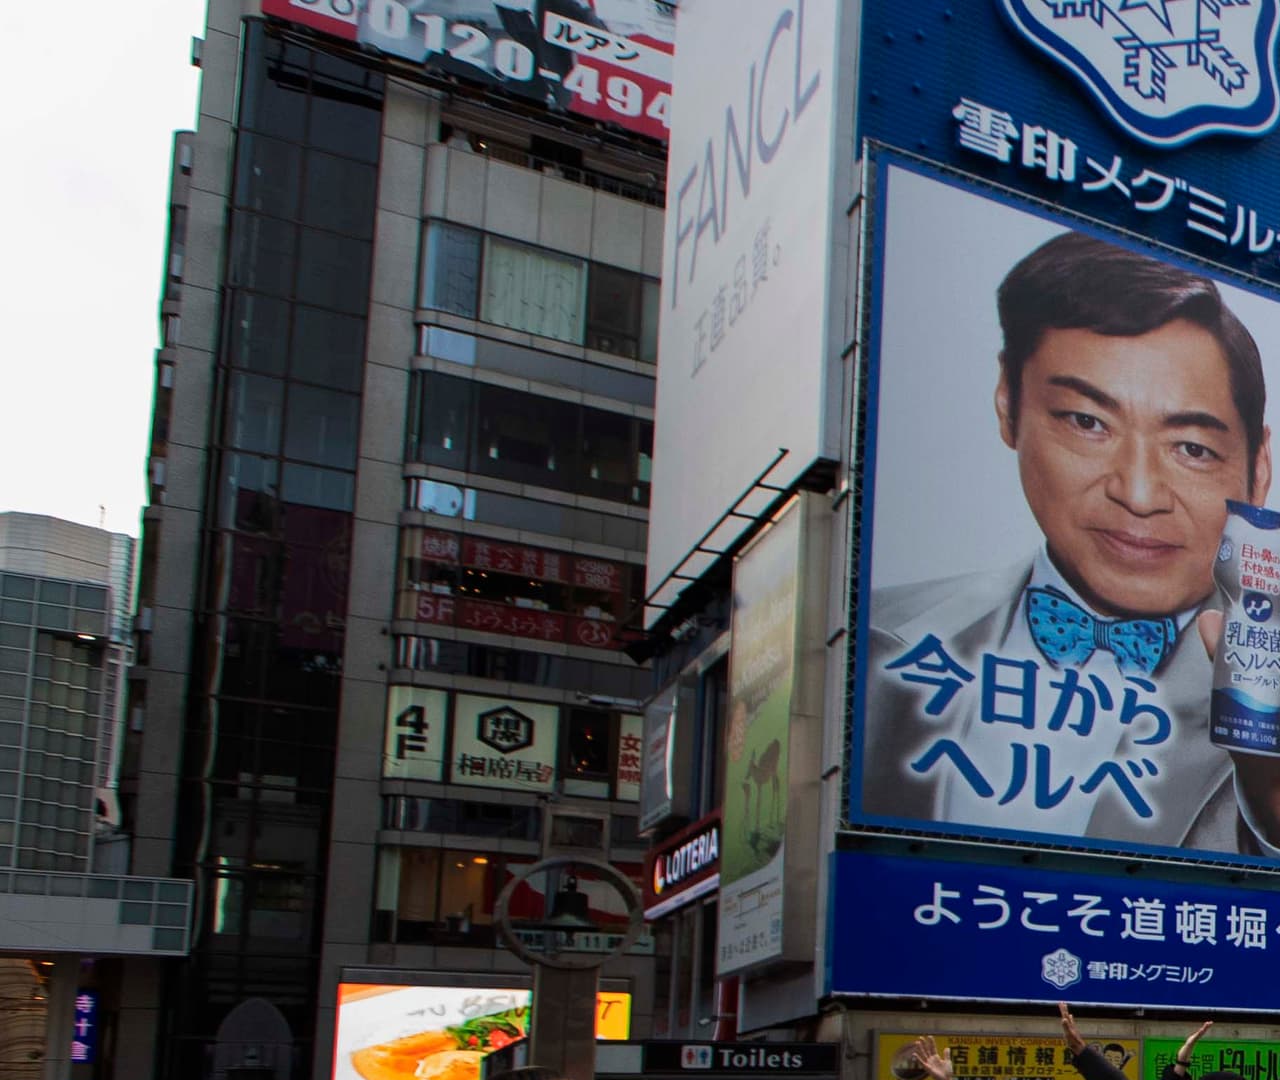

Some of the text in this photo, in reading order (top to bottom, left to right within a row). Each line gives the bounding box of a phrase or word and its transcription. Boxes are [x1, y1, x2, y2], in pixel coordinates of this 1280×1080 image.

[552, 21, 641, 62] ルアン
[672, 0, 821, 311] FANCL
[884, 632, 1173, 747] 今日から
[1232, 672, 1279, 690] ヨーグルト
[665, 827, 719, 885] LOTTERIA
[1086, 959, 1215, 986] 雪印メグミルク
[719, 1047, 804, 1068] Toilets
